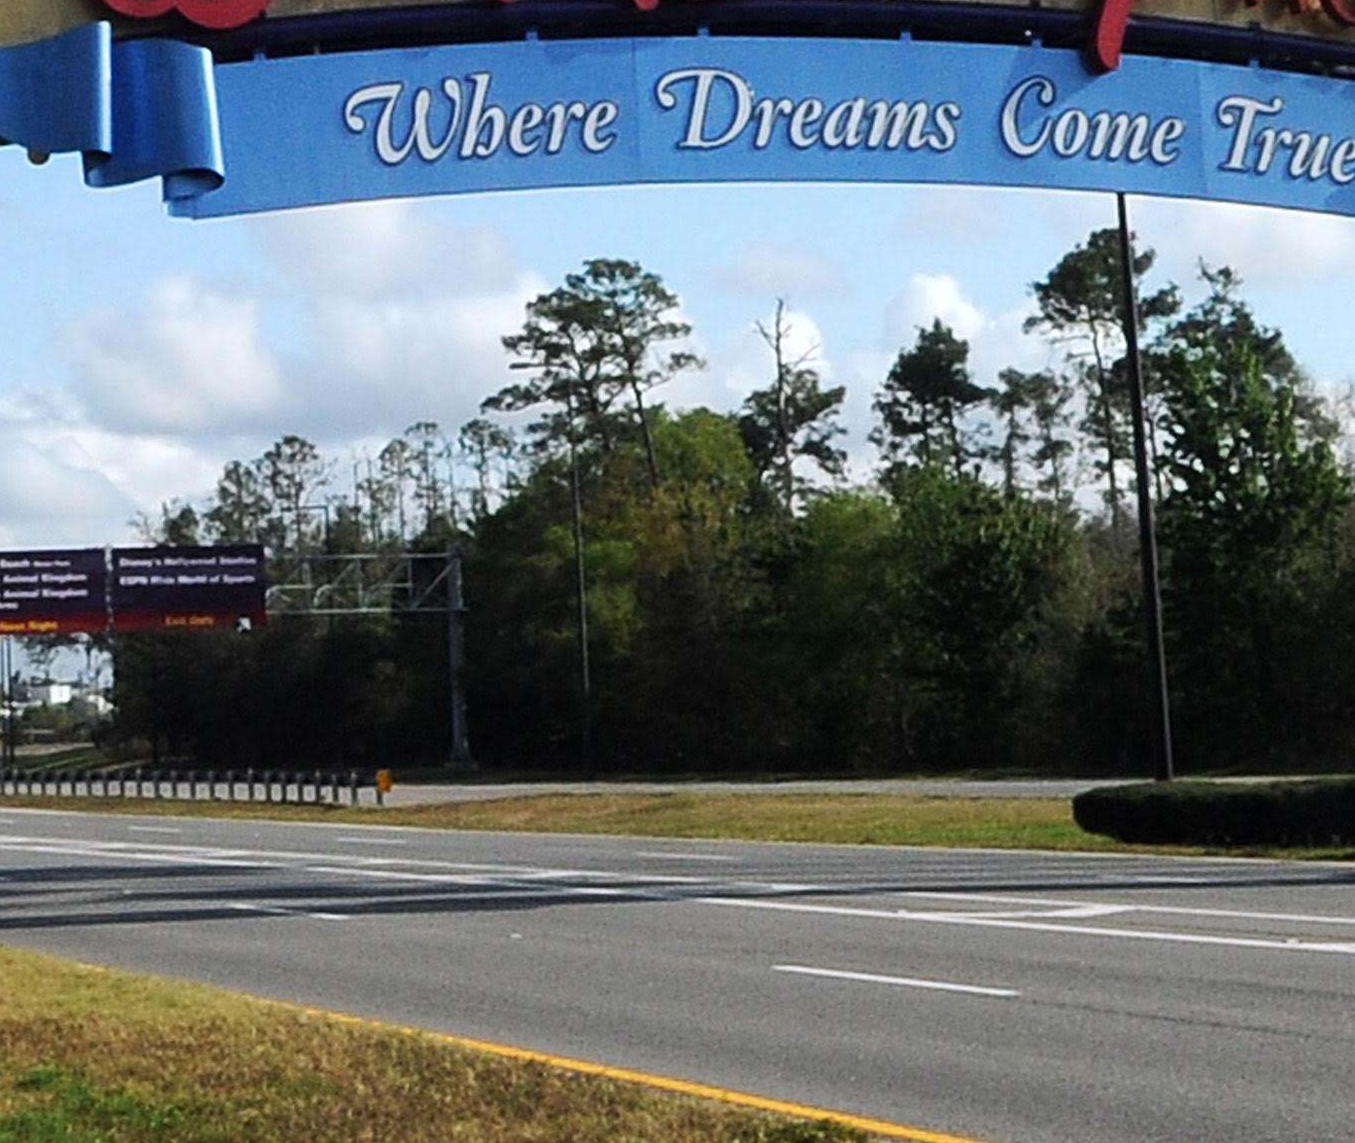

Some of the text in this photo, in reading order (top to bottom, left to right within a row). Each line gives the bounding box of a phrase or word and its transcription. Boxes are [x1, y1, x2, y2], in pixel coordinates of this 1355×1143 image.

[344, 72, 619, 166] Where
[655, 67, 960, 153] Dreams
[999, 76, 1186, 166] Come
